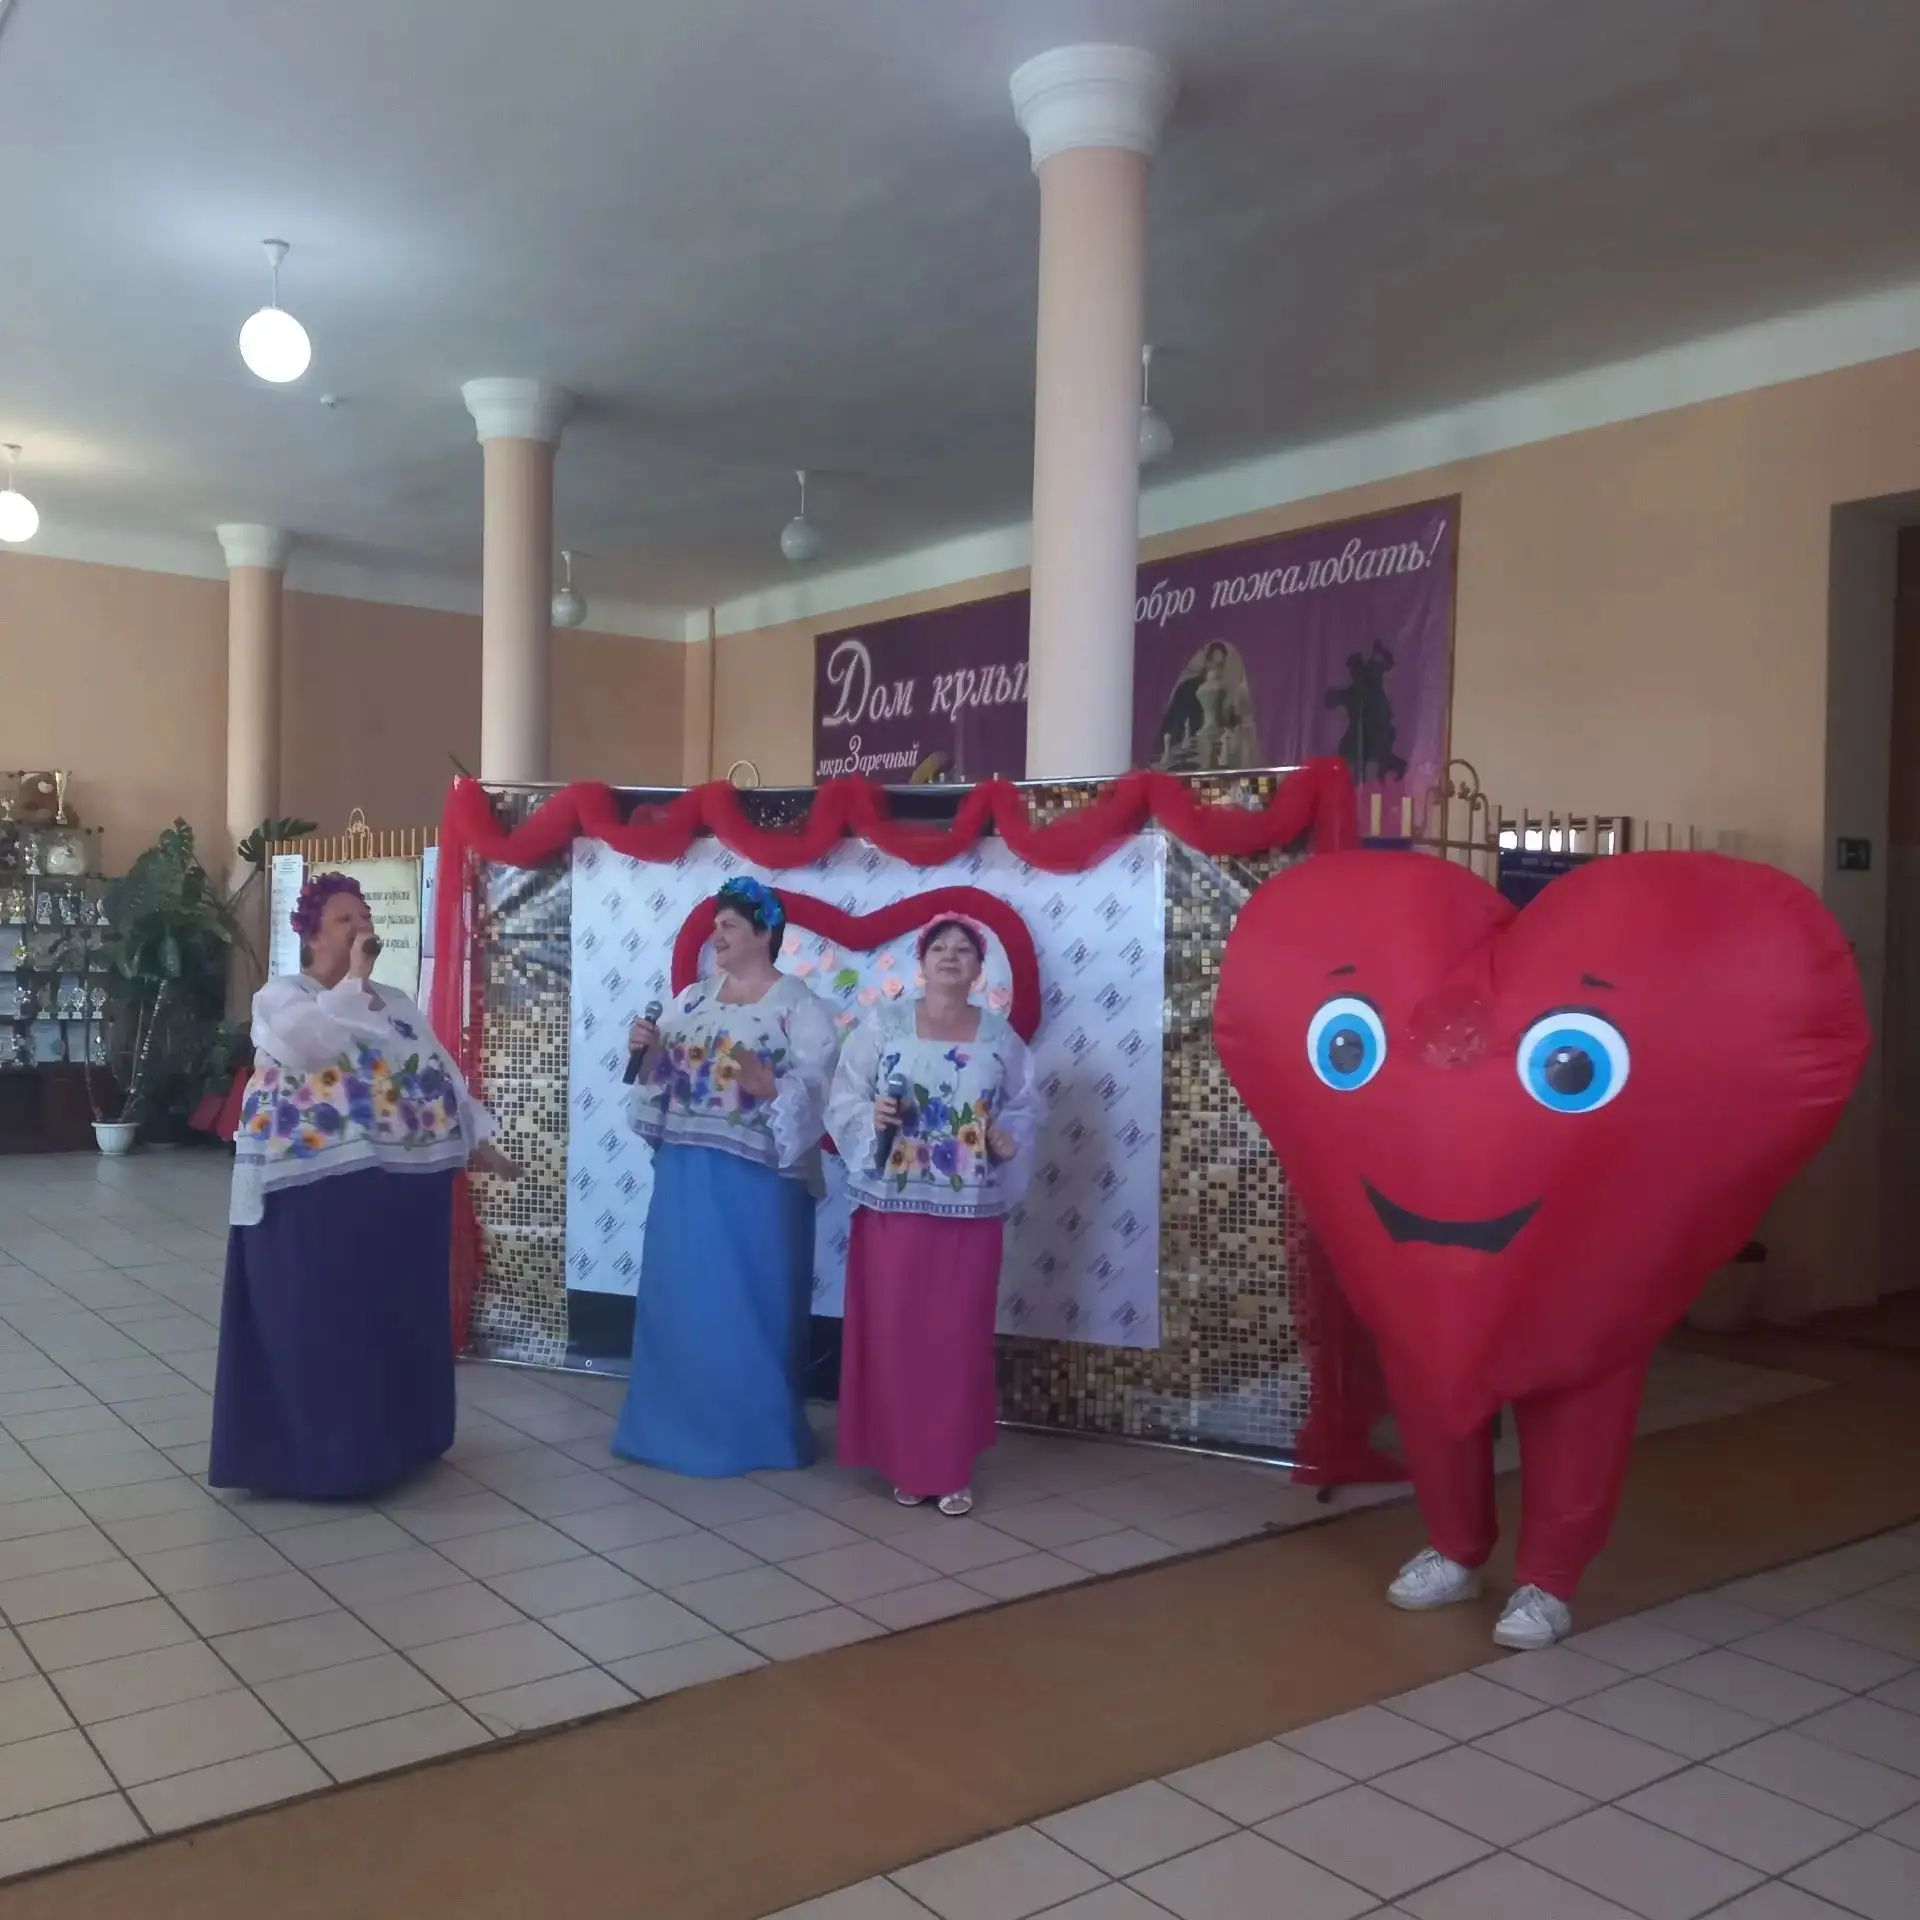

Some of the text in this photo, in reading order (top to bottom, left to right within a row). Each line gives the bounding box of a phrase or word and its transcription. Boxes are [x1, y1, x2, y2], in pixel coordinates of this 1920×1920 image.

[1135, 519, 1447, 627] обро пожаловать!
[822, 640, 914, 727] Дом
